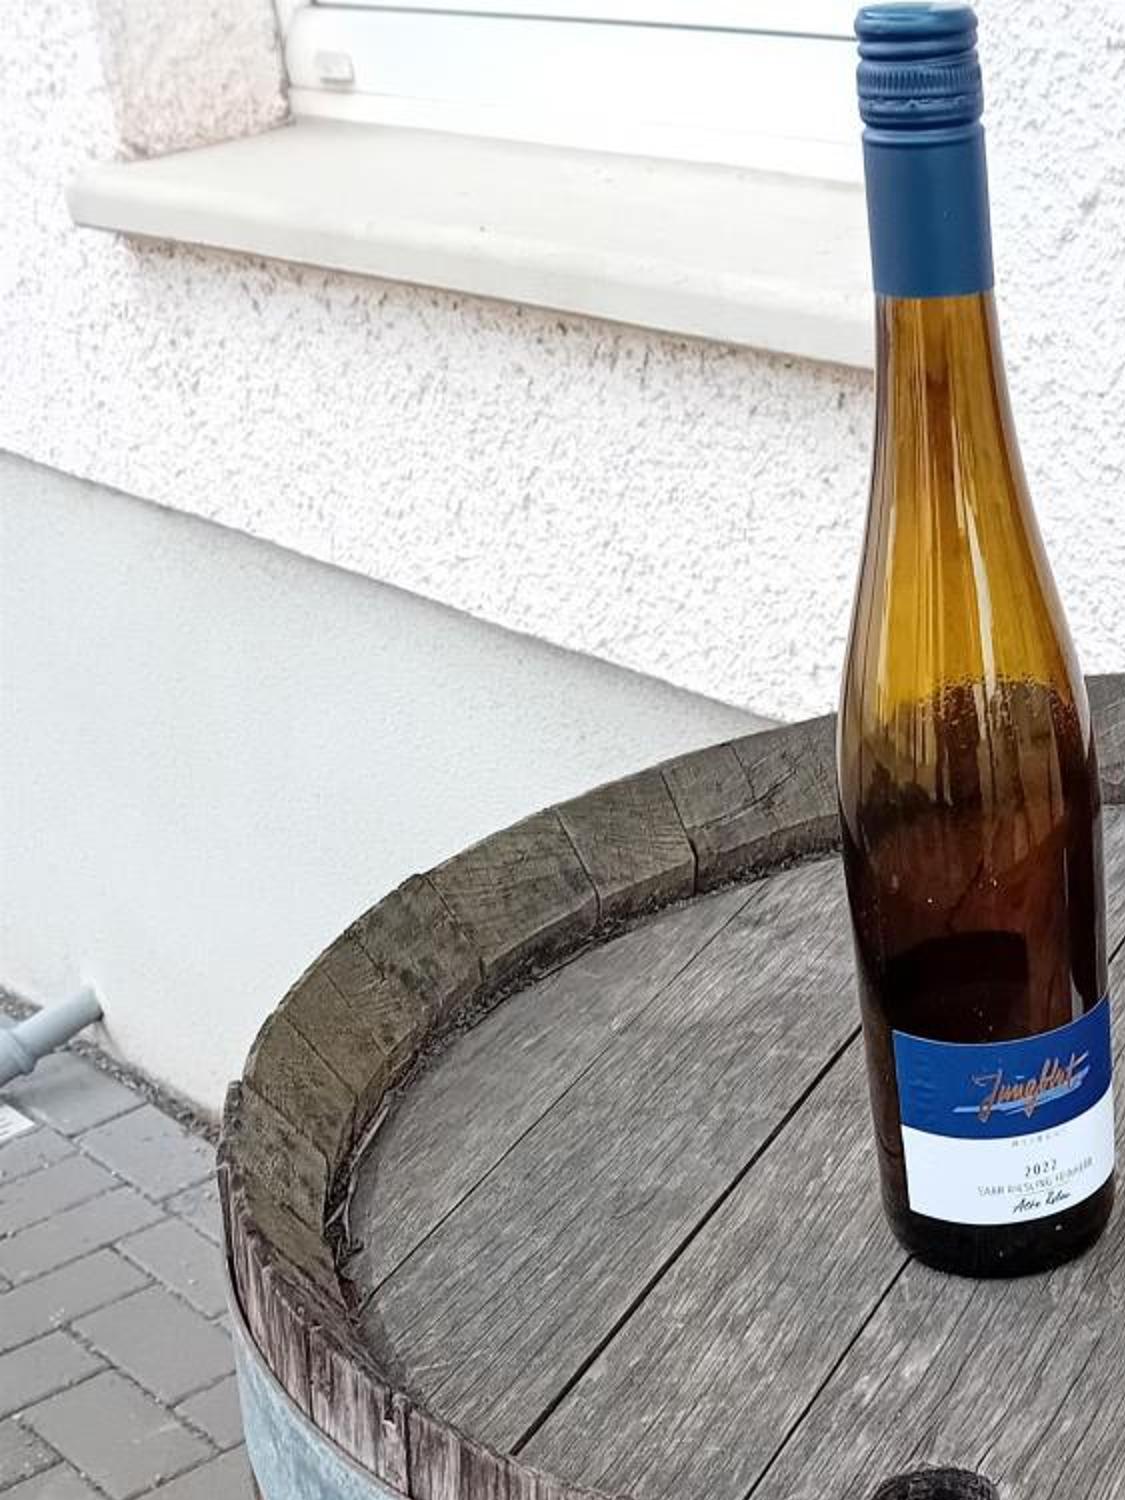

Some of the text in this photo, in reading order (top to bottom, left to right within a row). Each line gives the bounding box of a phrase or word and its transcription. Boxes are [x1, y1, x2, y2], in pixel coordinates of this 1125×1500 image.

[970, 1050, 1089, 1123] Jungblut
[1024, 1158, 1058, 1178] 2022
[978, 1185, 1005, 1197] SAAR
[1007, 1178, 1052, 1195] RIESLING
